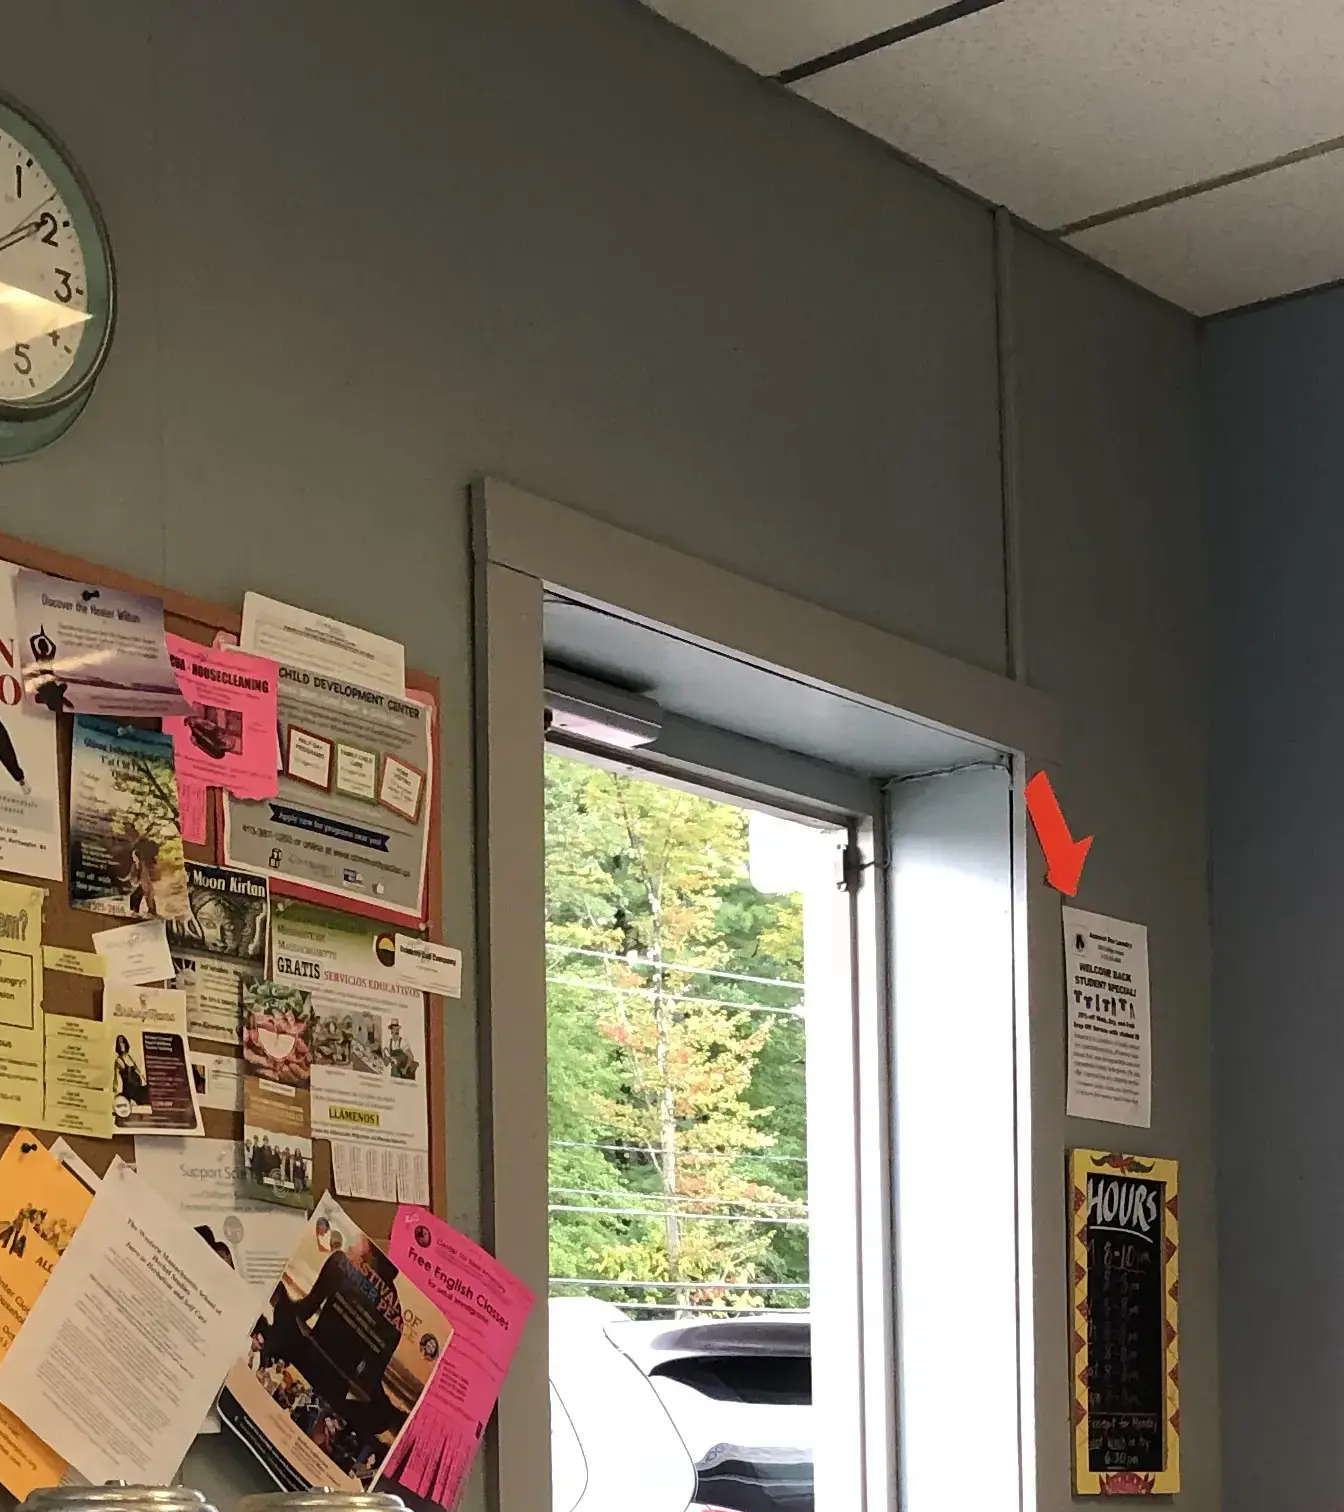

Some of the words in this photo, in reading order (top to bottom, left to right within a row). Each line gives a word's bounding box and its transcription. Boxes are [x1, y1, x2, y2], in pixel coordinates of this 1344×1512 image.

[16, 165, 22, 198] 1
[40, 212, 58, 247] 2
[54, 268, 72, 303] 3
[14, 343, 32, 375] 5
[41, 593, 73, 610] Discover
[76, 601, 88, 614] the
[192, 663, 269, 693] HOUSECLEANING
[278, 666, 310, 685] CHILD
[314, 677, 384, 707] DEVELOPMENT
[387, 699, 420, 720] CENTER
[278, 811, 298, 824] Apply
[193, 870, 225, 891] Moon
[230, 877, 265, 897] Kirtan
[277, 956, 321, 979] GRATIS
[324, 970, 367, 987] SERVICIOS
[368, 979, 421, 998] EDUCATIVOS
[1074, 975, 1107, 990] STUDENT
[1108, 983, 1137, 997] SPECIAL!
[1079, 962, 1112, 977] WELCOME
[1113, 970, 1132, 983] BACK
[179, 1164, 222, 1180] Support
[1087, 1177, 1158, 1232] HOURS
[127, 1217, 138, 1231] The
[163, 1252, 199, 1291] Massachusetts
[199, 1289, 216, 1310] School
[152, 1255, 171, 1278] Herbal
[171, 1277, 191, 1296] Studies
[408, 1247, 431, 1271] Free
[434, 1266, 473, 1300] English
[476, 1294, 509, 1331] Classes
[428, 1279, 436, 1288] for
[437, 1287, 453, 1301] adult
[376, 1302, 420, 1344] PEACE
[404, 1310, 422, 1328] OF
